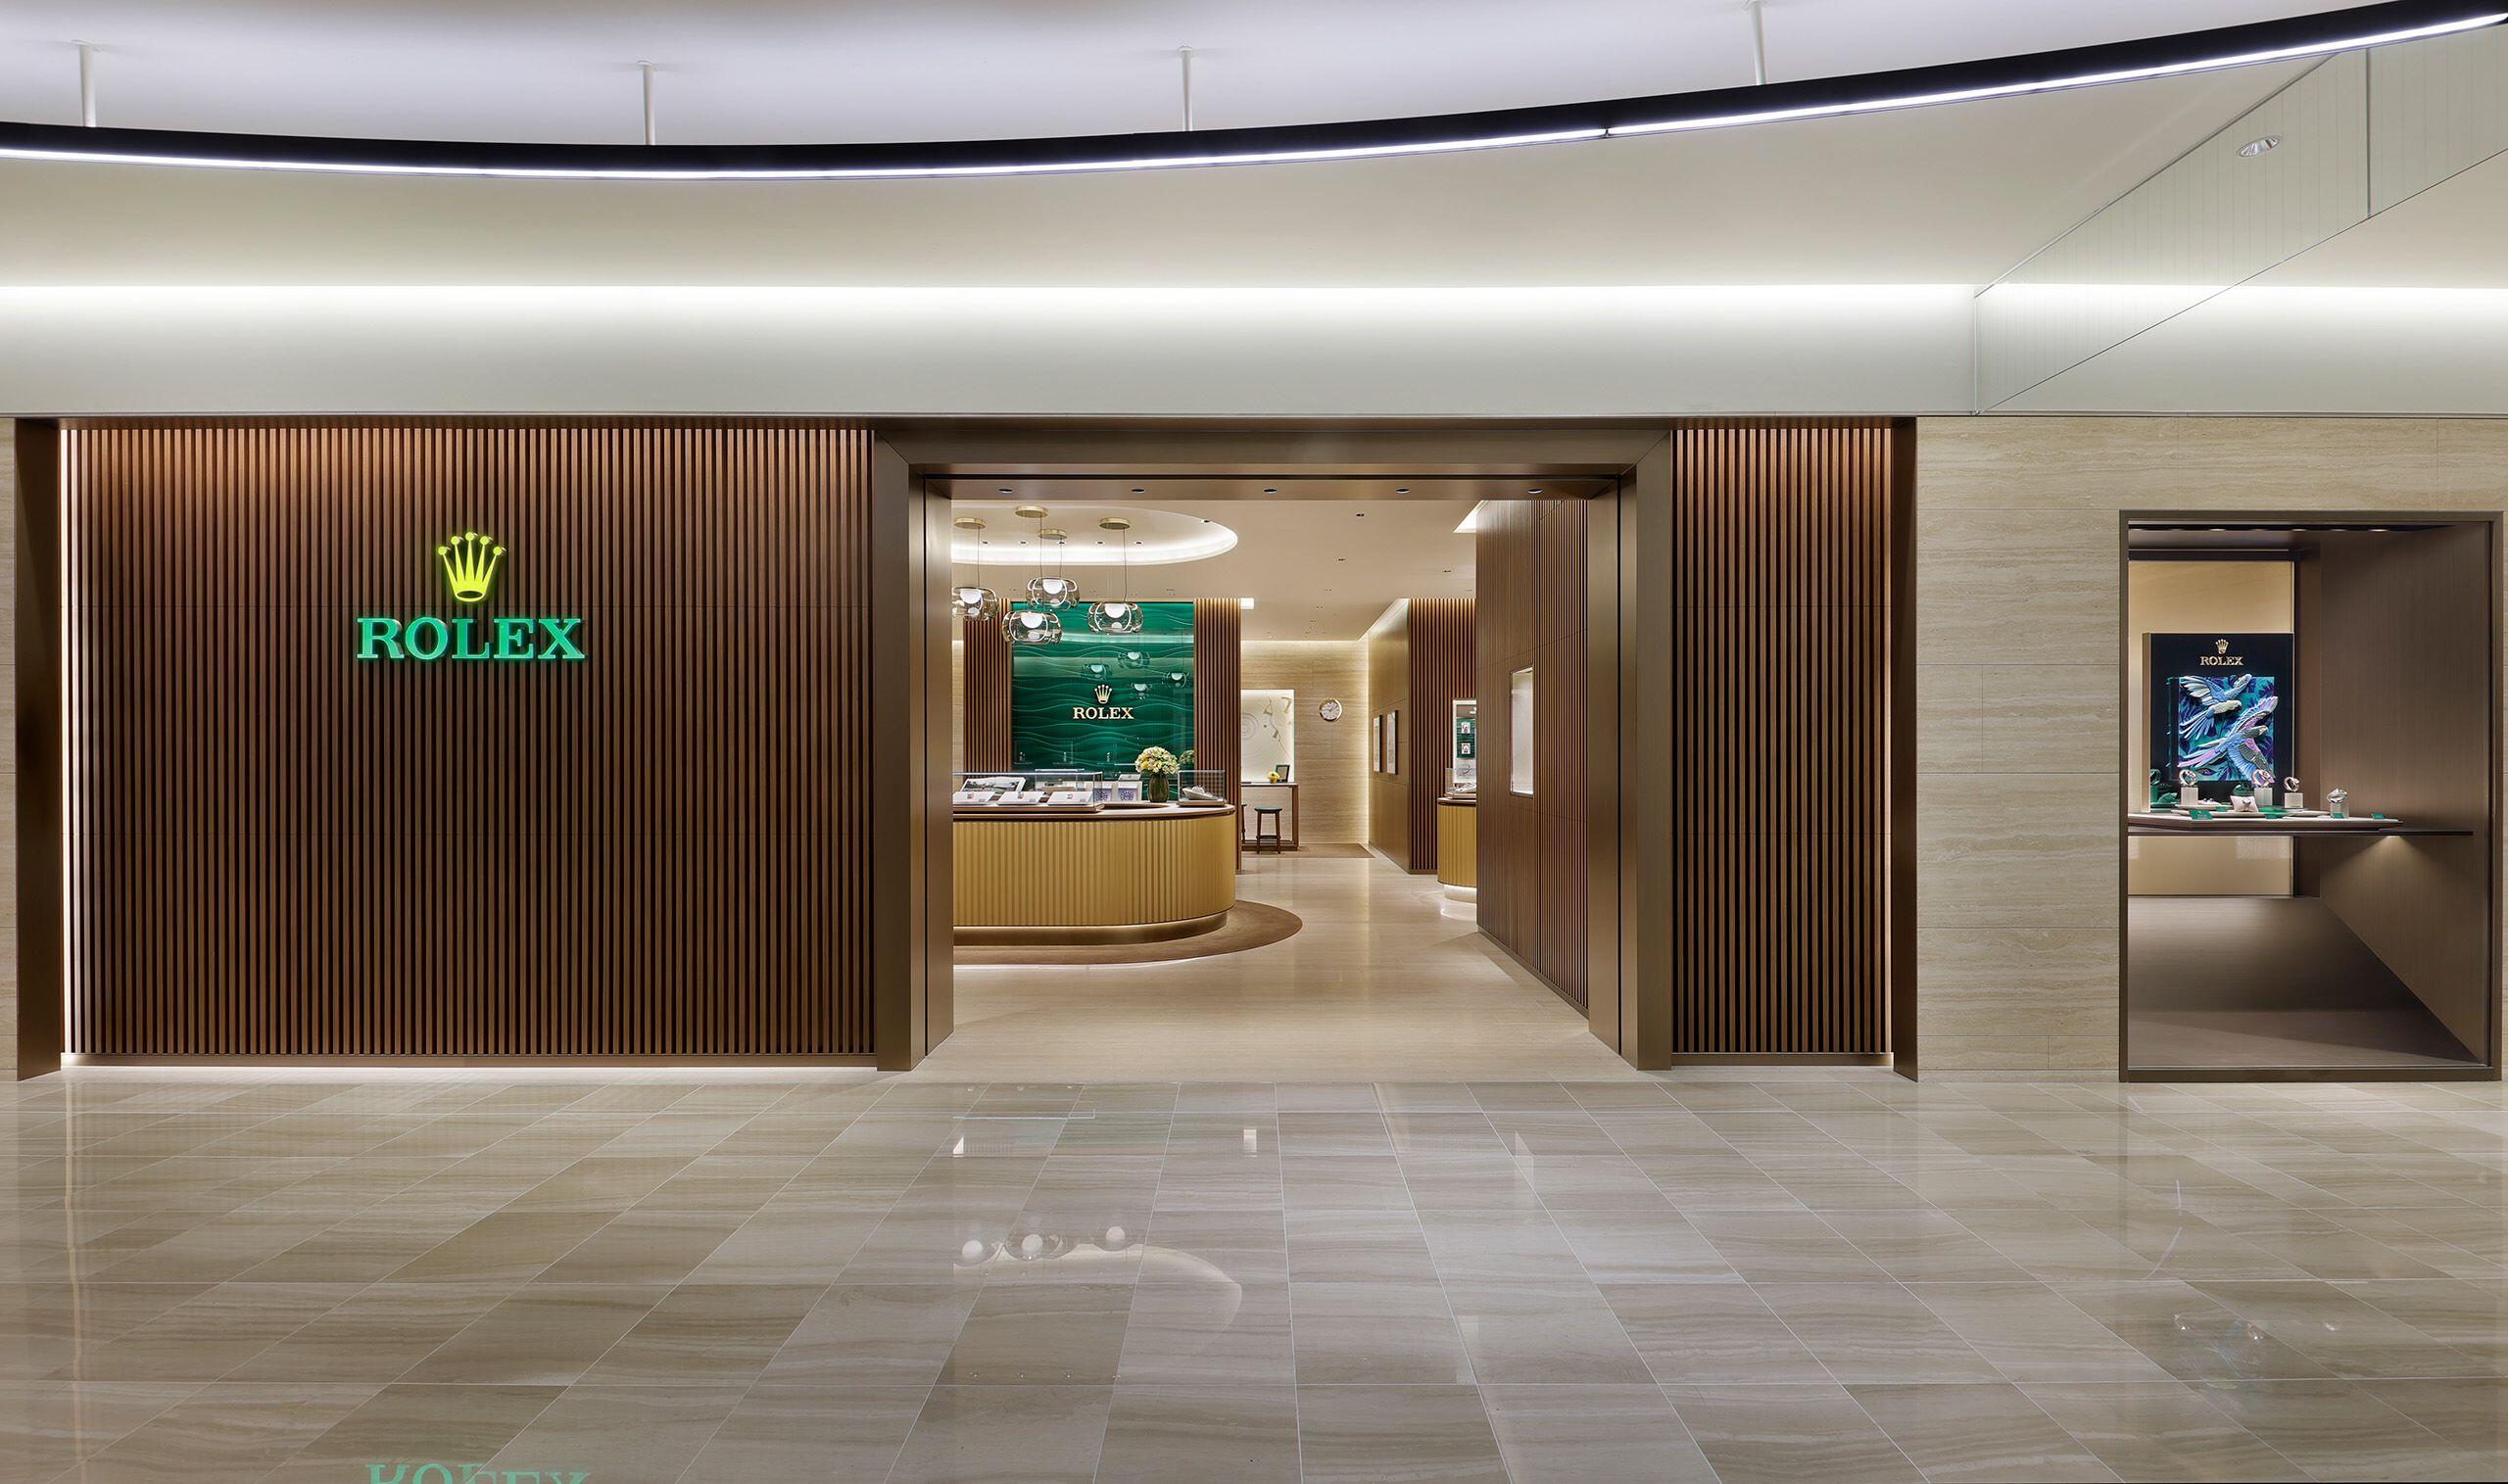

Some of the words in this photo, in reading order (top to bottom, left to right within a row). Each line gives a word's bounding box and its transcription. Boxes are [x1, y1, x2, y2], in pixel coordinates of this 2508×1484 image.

[357, 616, 586, 660] ROLEX
[2199, 655, 2243, 666] ROLEX
[1073, 706, 1134, 720] ROLEX
